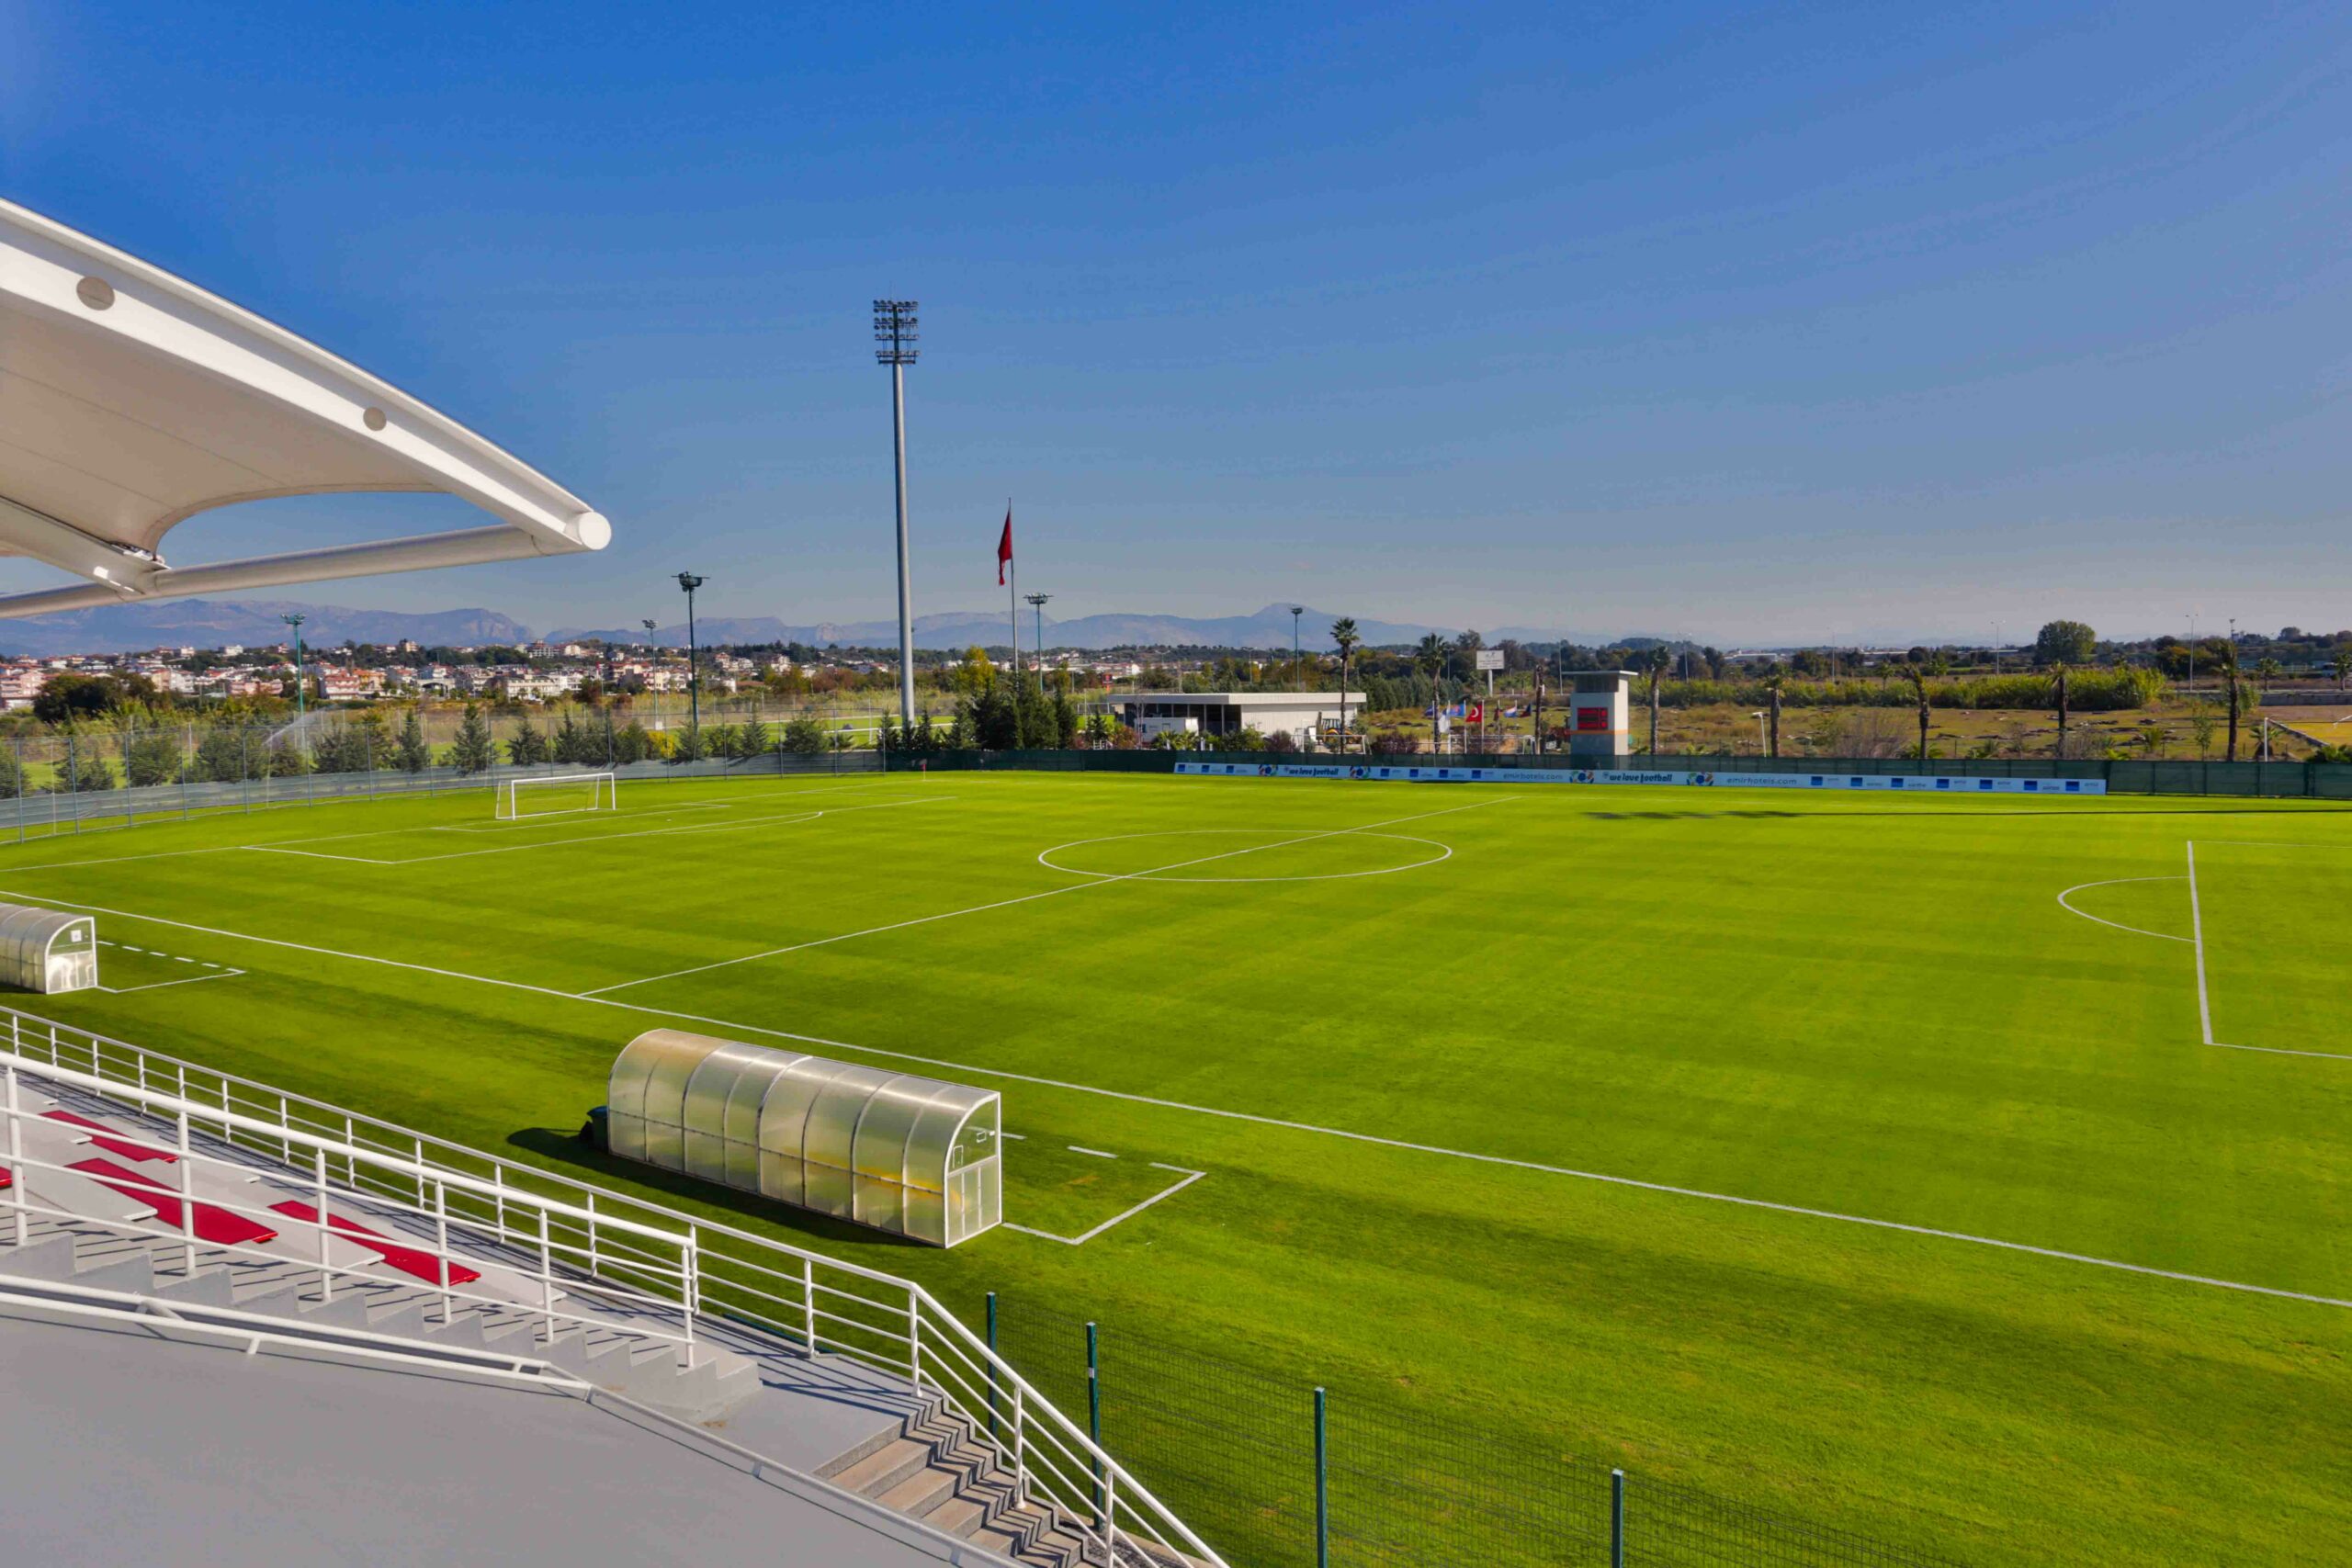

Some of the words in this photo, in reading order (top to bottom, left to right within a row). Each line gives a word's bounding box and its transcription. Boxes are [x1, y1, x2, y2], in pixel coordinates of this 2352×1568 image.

[1313, 767, 1339, 776] football
[1623, 773, 1639, 781] love
[1640, 773, 1673, 784] football
